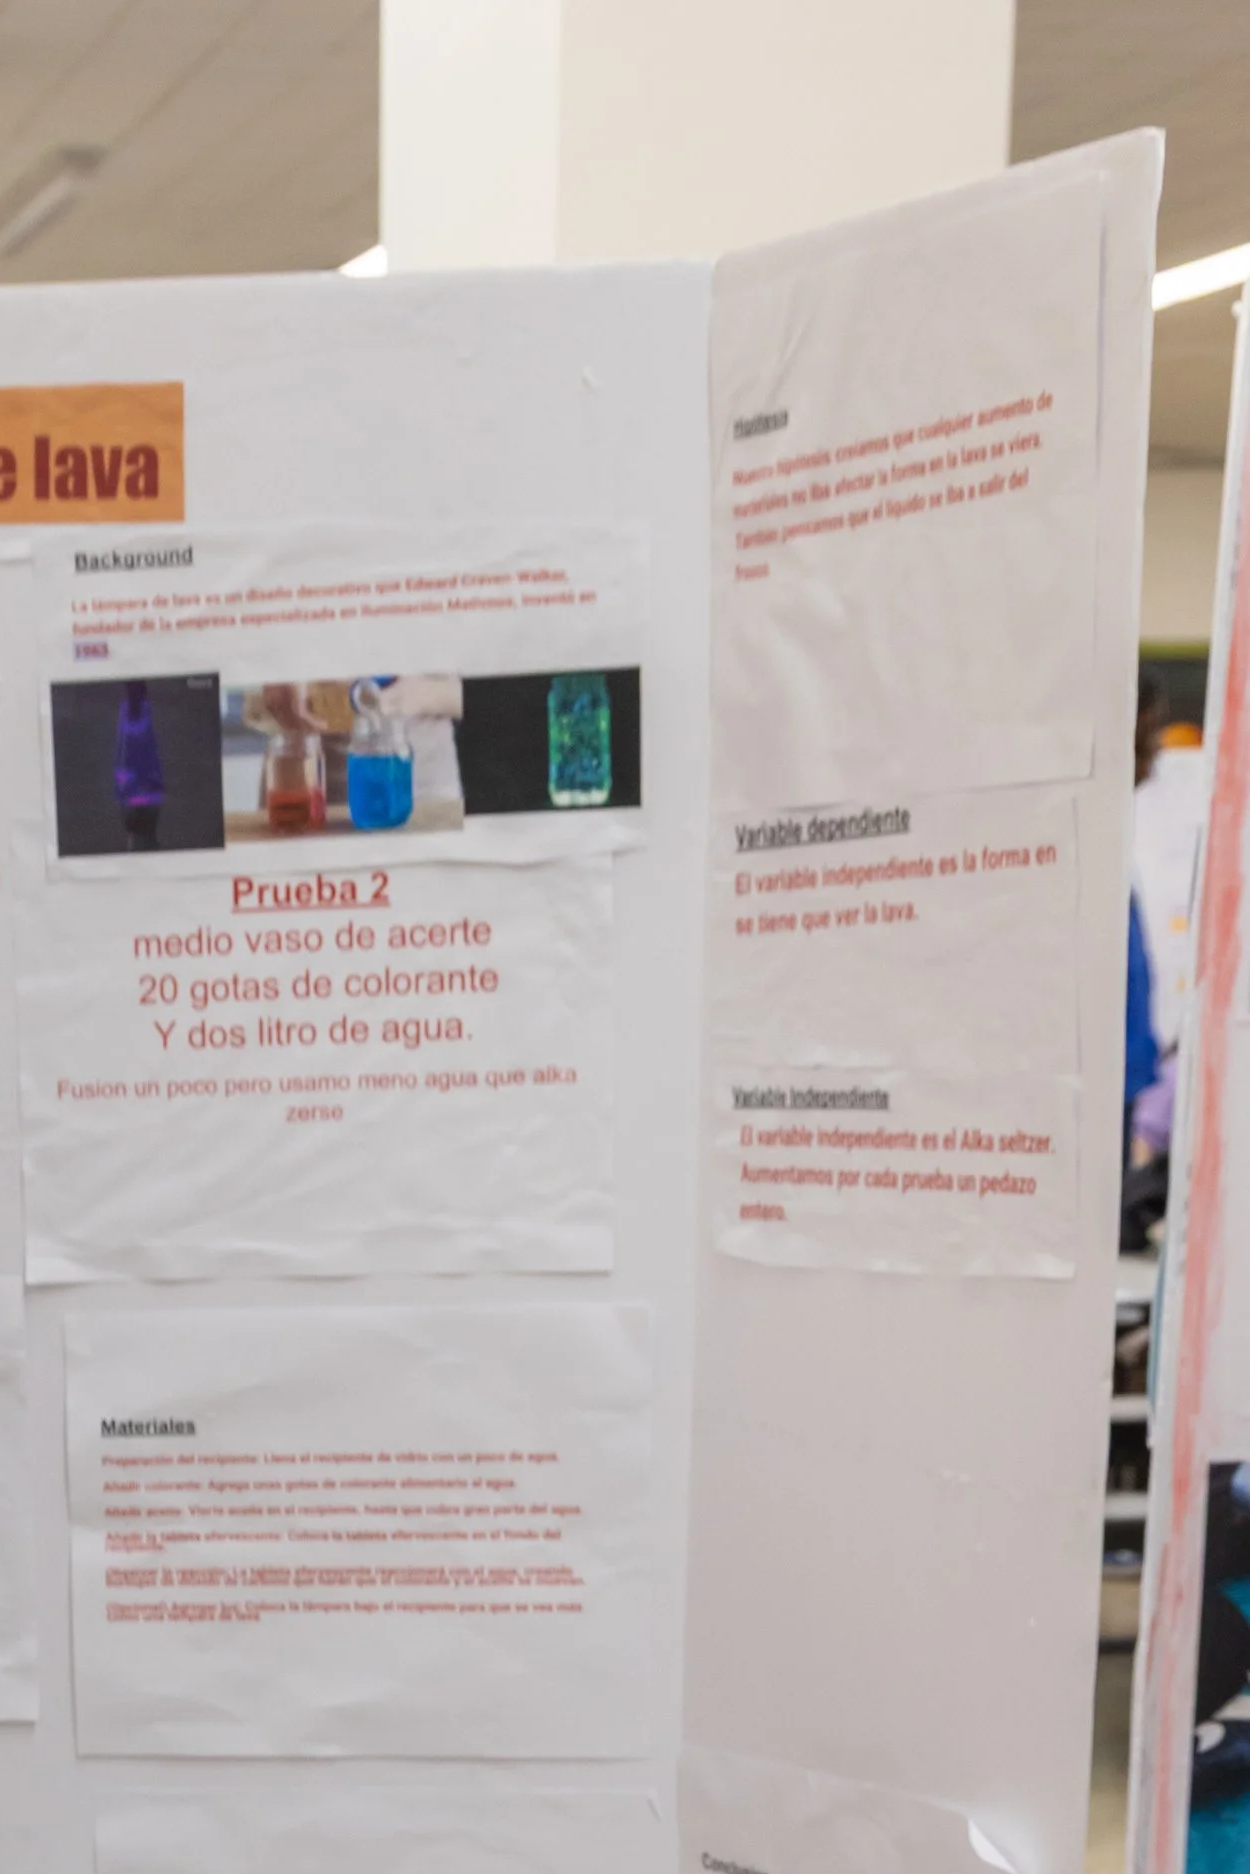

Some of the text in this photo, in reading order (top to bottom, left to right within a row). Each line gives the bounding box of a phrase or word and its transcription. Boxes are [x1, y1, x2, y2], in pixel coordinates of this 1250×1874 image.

[32, 433, 160, 502] lava
[73, 544, 193, 573] Background
[231, 869, 389, 913] Prueba 2
[133, 925, 234, 959] medio
[244, 928, 323, 954] vaso
[334, 919, 375, 951] de
[138, 963, 499, 1011] 20 gotas de colorante
[154, 1013, 473, 1050] Y dos litro de agua.
[100, 1417, 195, 1438] Materiales
